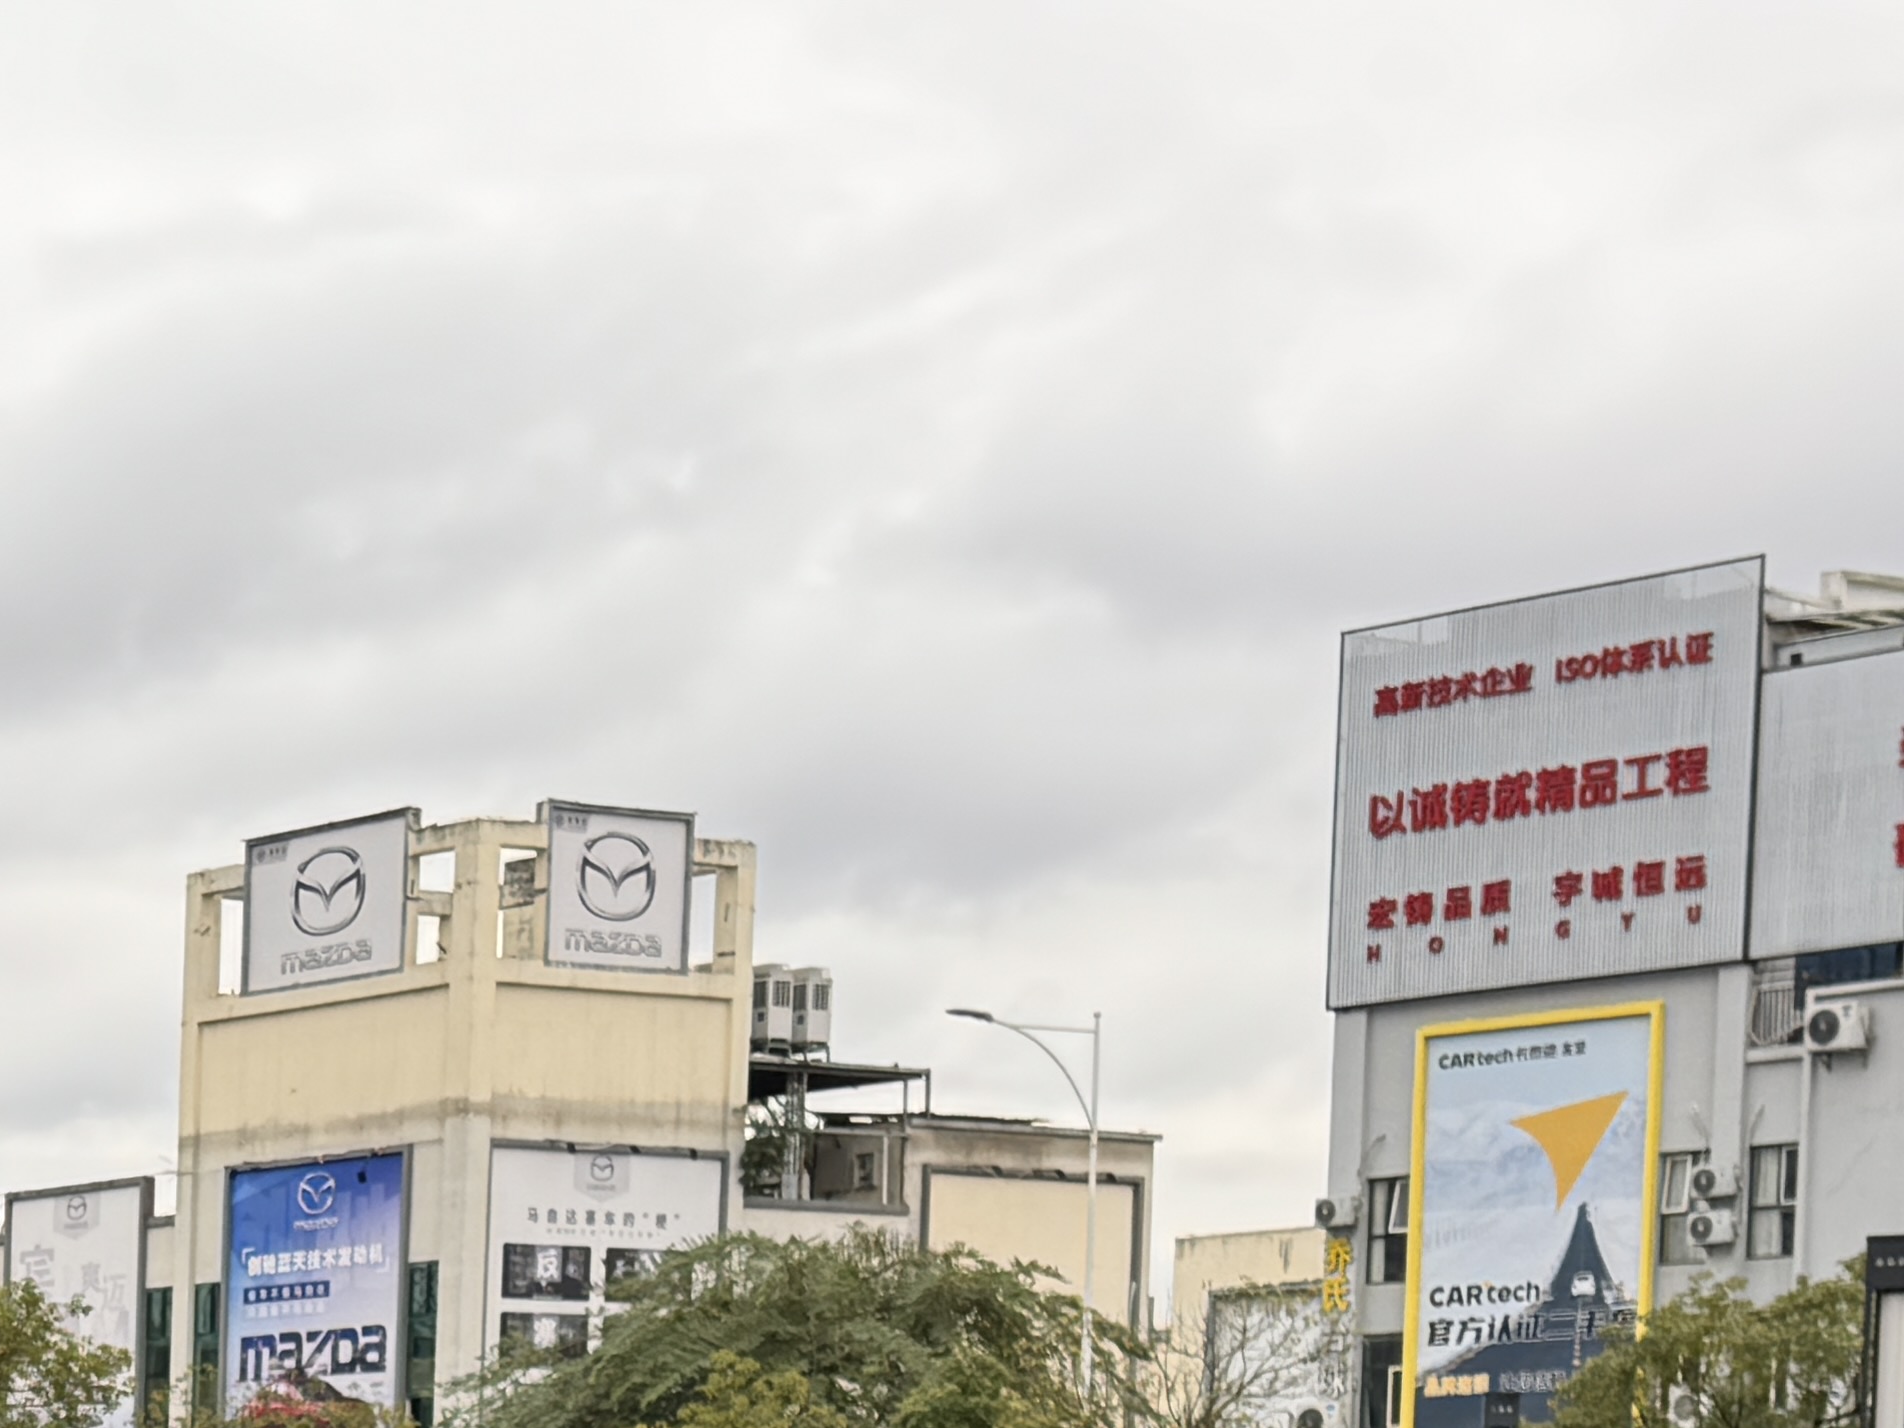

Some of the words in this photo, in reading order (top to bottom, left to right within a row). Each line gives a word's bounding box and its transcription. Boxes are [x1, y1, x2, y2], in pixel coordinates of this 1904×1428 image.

[1372, 661, 1534, 719] 高新技术企业
[1554, 630, 1715, 685] ISO体系认证
[1368, 745, 1710, 840] 以诚铸就精品工程
[279, 938, 373, 977] mazda
[563, 926, 663, 958] mazda
[1429, 1279, 1541, 1308] CARtech
[238, 1323, 388, 1382] mazda
